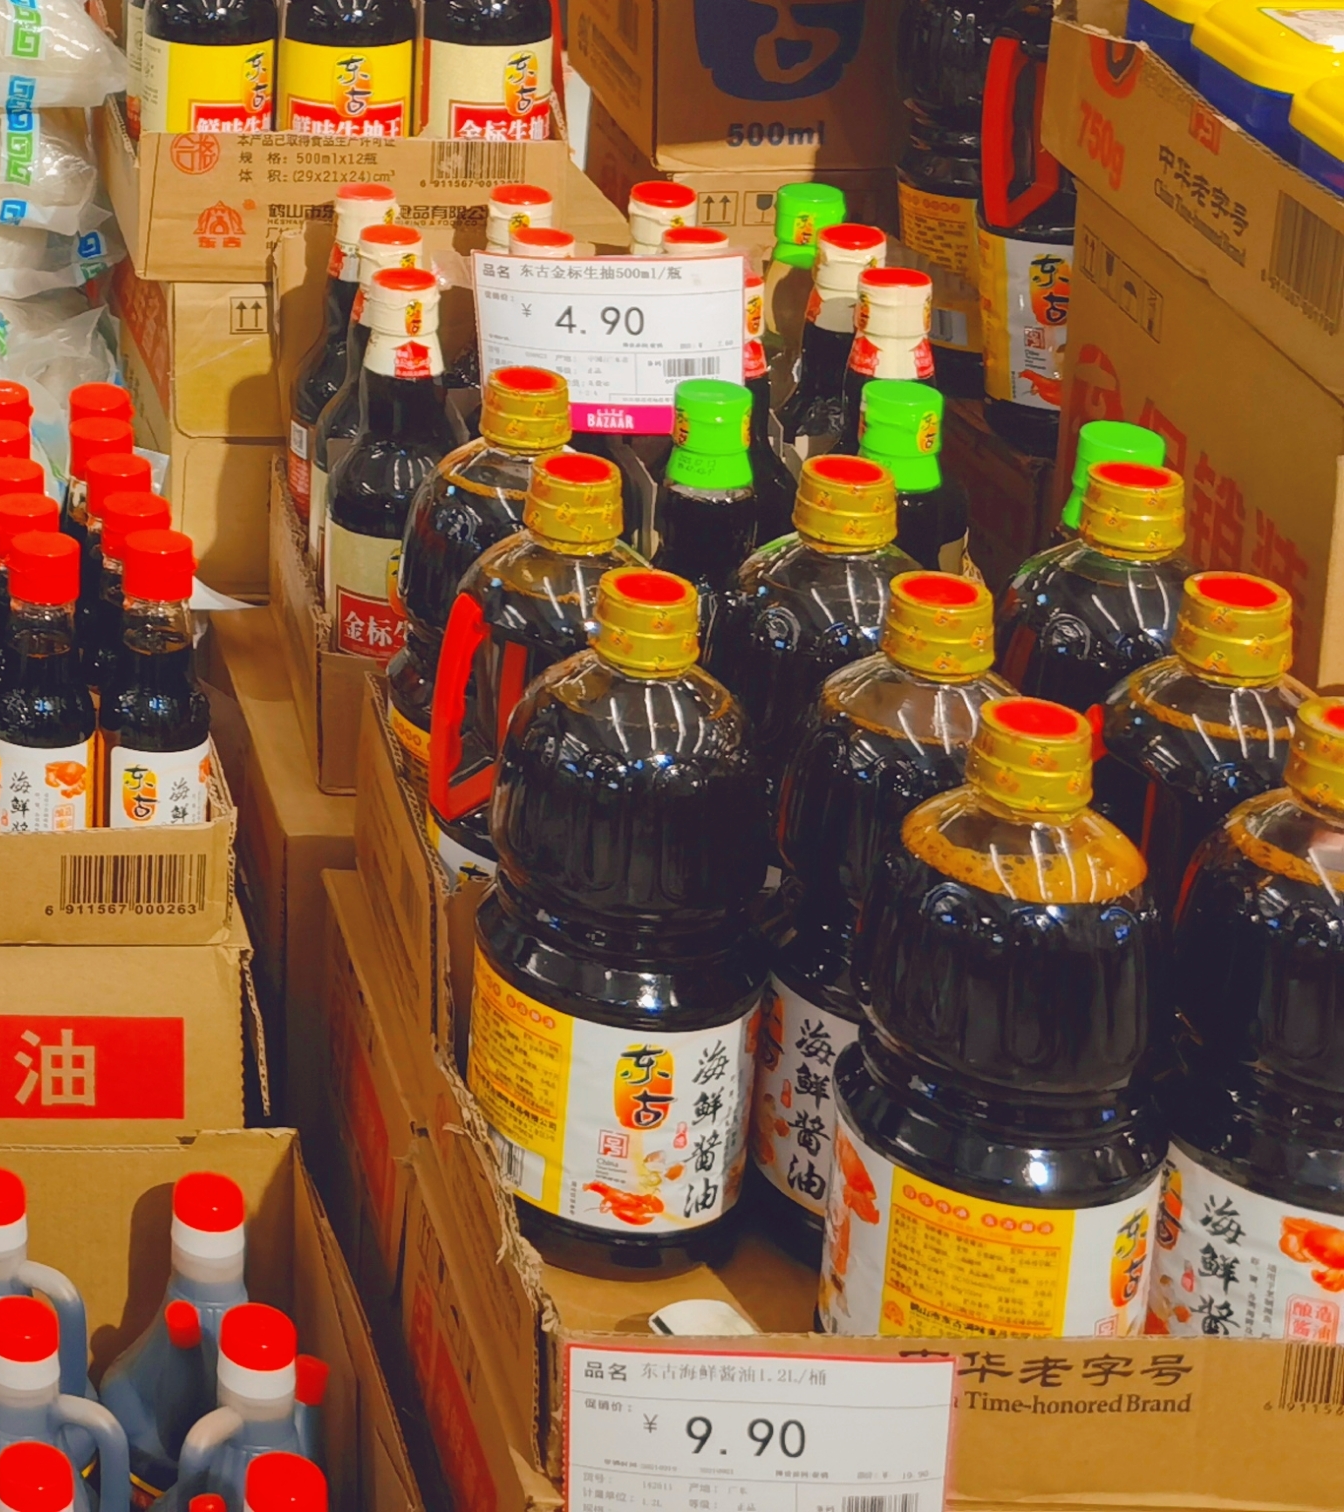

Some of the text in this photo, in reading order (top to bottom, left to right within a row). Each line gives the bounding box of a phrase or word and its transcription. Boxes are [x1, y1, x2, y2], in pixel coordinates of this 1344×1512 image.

[334, 54, 374, 115] 东古
[505, 52, 539, 111] 东古
[726, 121, 827, 149] 500ml
[1078, 99, 1126, 191] 750g
[429, 179, 473, 189] 911567
[1158, 144, 1249, 238] 中华老字号
[483, 263, 682, 281] 品名 东古金标生抽500ml/瓶
[1031, 254, 1071, 323] 东古
[520, 303, 645, 336] ¥ 4.90
[587, 413, 634, 430] BAZAAR
[342, 611, 414, 647] 金标生
[123, 765, 160, 819] 东古
[44, 903, 198, 917] 6 911567 000263
[620, 1043, 678, 1128] 东古
[683, 1039, 731, 1219] 海鲜酱油
[788, 1017, 837, 1201] 海鲜酱油
[1189, 1194, 1247, 1336] 海鲜酱
[583, 1361, 828, 1386] 品名 东古海鲜酱油1.2L/桶
[899, 1349, 1194, 1387] 华老字号
[584, 1398, 633, 1414] 促销价:
[963, 1390, 1192, 1415] Time-honored Brand
[641, 1413, 807, 1458] ¥ 9.90
